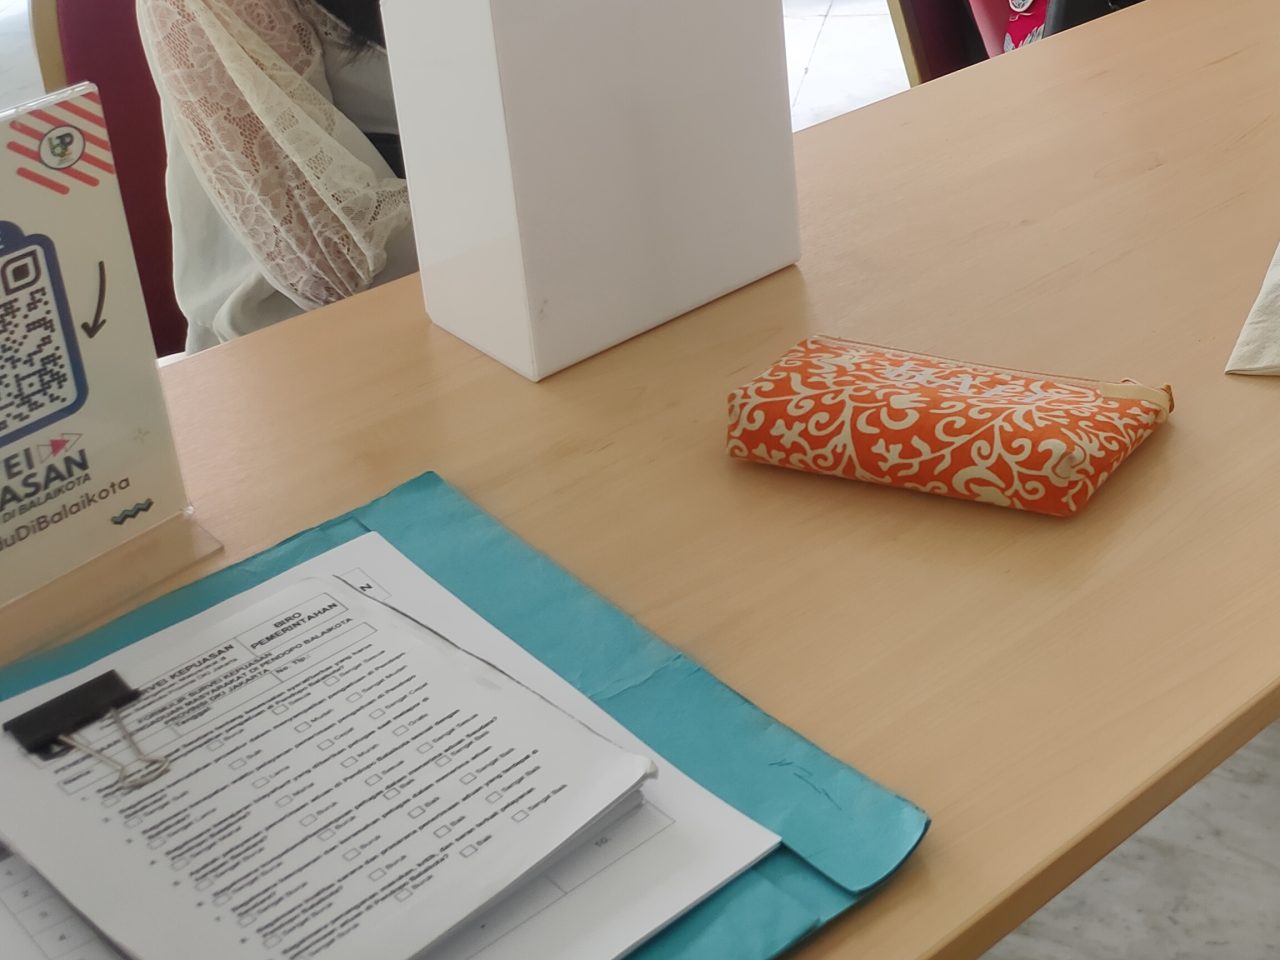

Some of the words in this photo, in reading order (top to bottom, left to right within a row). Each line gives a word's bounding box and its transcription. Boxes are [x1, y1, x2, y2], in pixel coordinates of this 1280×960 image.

[0, 477, 131, 552] uDiBalaikota
[18, 473, 92, 516] BALAIKOTA
[250, 602, 339, 650] PEMERINTAHAN
[260, 643, 303, 668] PENDOPO
[302, 617, 353, 646] BALAIKOTA
[273, 612, 302, 628] BIRO
[169, 644, 234, 680] KEPUASAN
